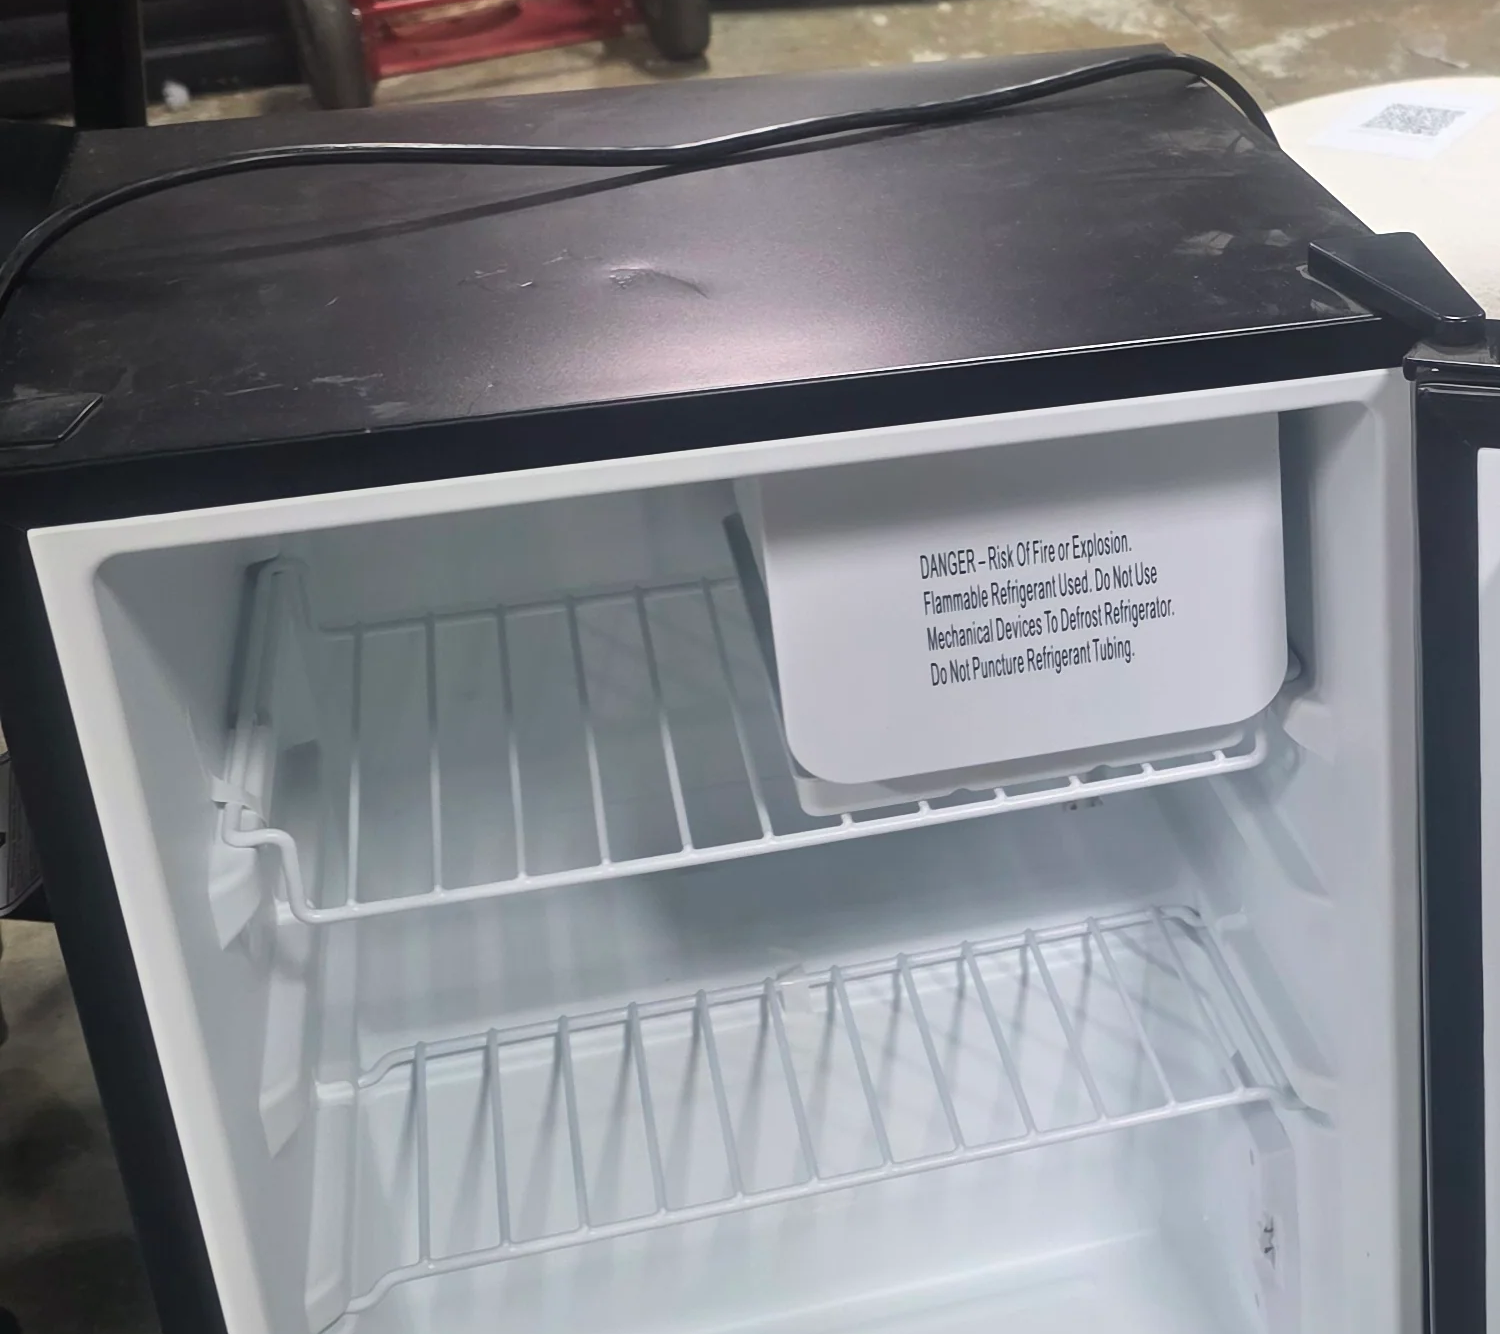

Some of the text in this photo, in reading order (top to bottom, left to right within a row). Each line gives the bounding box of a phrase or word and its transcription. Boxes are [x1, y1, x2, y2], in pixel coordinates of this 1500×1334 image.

[919, 549, 976, 579] DANGER
[987, 545, 1014, 570] Risk
[1016, 541, 1030, 567] Of
[1032, 540, 1055, 564] Fire
[1057, 543, 1070, 561] or
[1071, 531, 1131, 563] Explosion.
[923, 562, 1157, 615] Flammable Refrigerant Used. Do Not Use
[926, 596, 1174, 651] Mechanical Devices To Defrost Refrigerator.
[930, 636, 1135, 686] Do Not Puncture Refrigerant Tubing.
